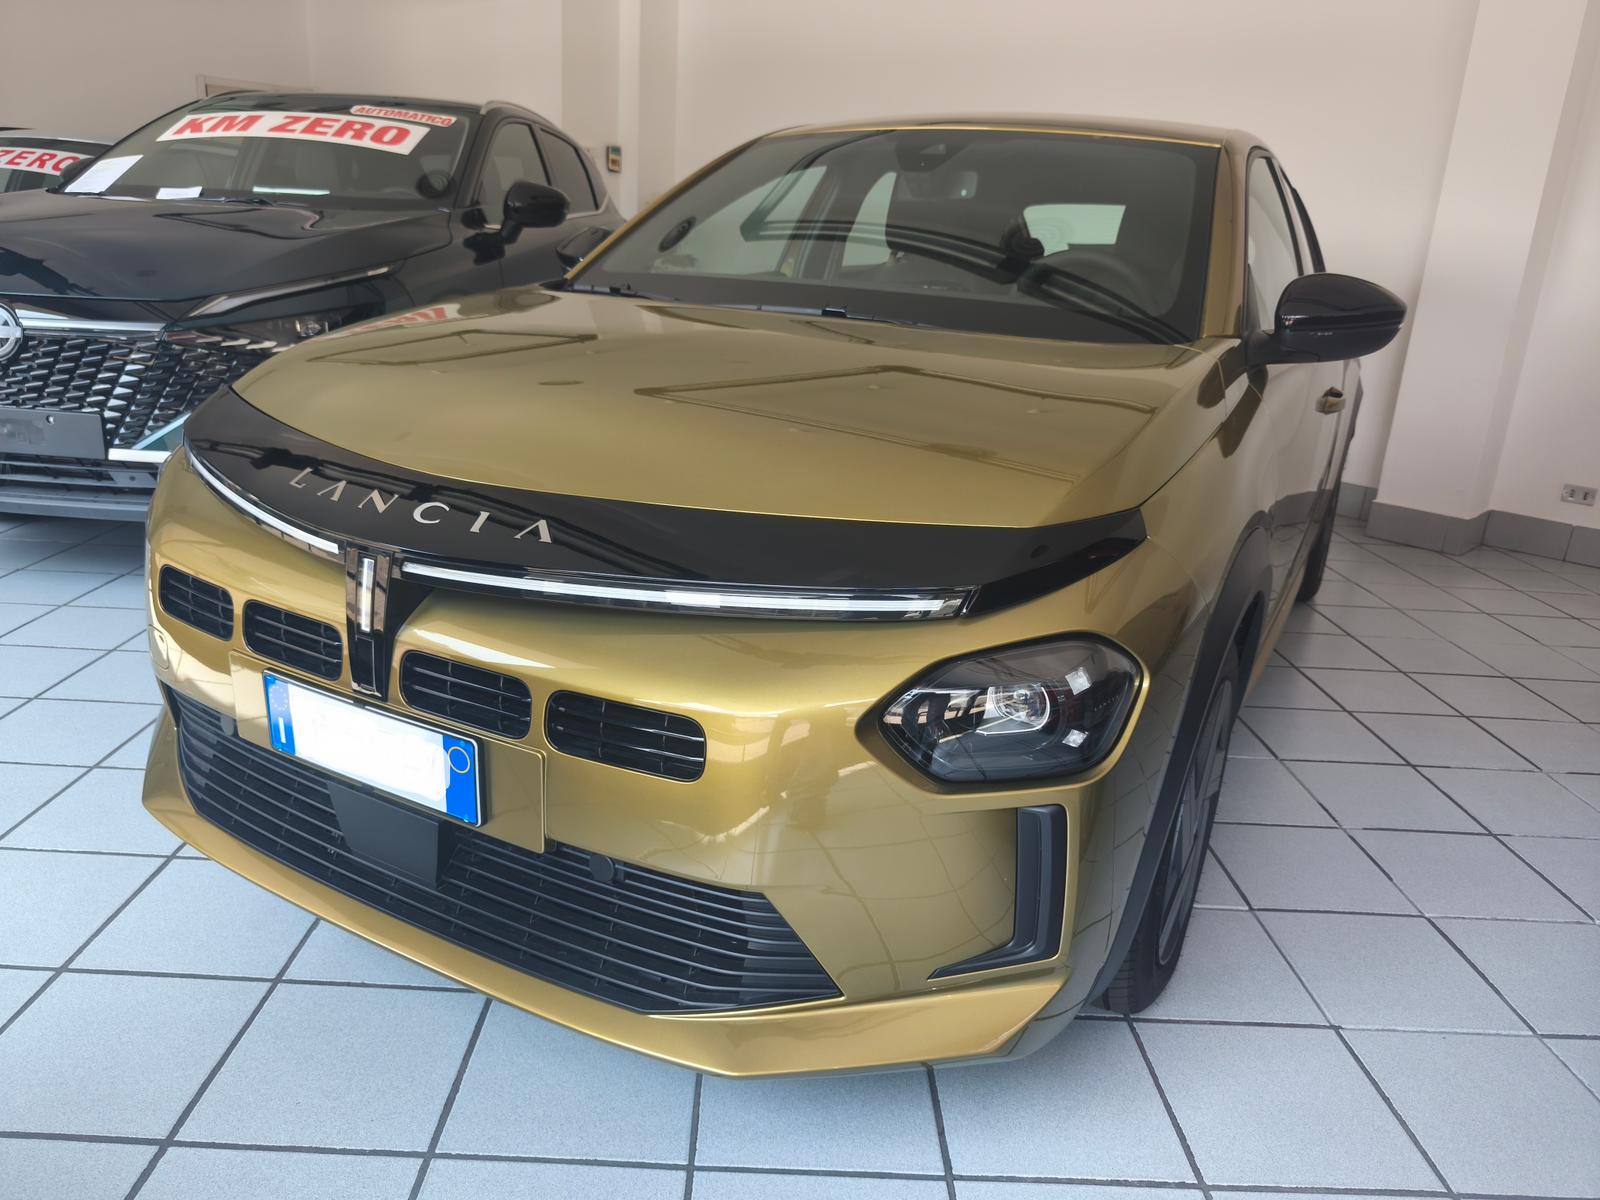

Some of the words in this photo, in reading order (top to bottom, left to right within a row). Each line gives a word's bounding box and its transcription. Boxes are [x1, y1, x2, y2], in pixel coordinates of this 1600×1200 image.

[173, 115, 265, 136] KM
[266, 115, 412, 147] ZERO
[355, 105, 454, 127] AUTOMATICO
[289, 467, 553, 544] LANCIA
